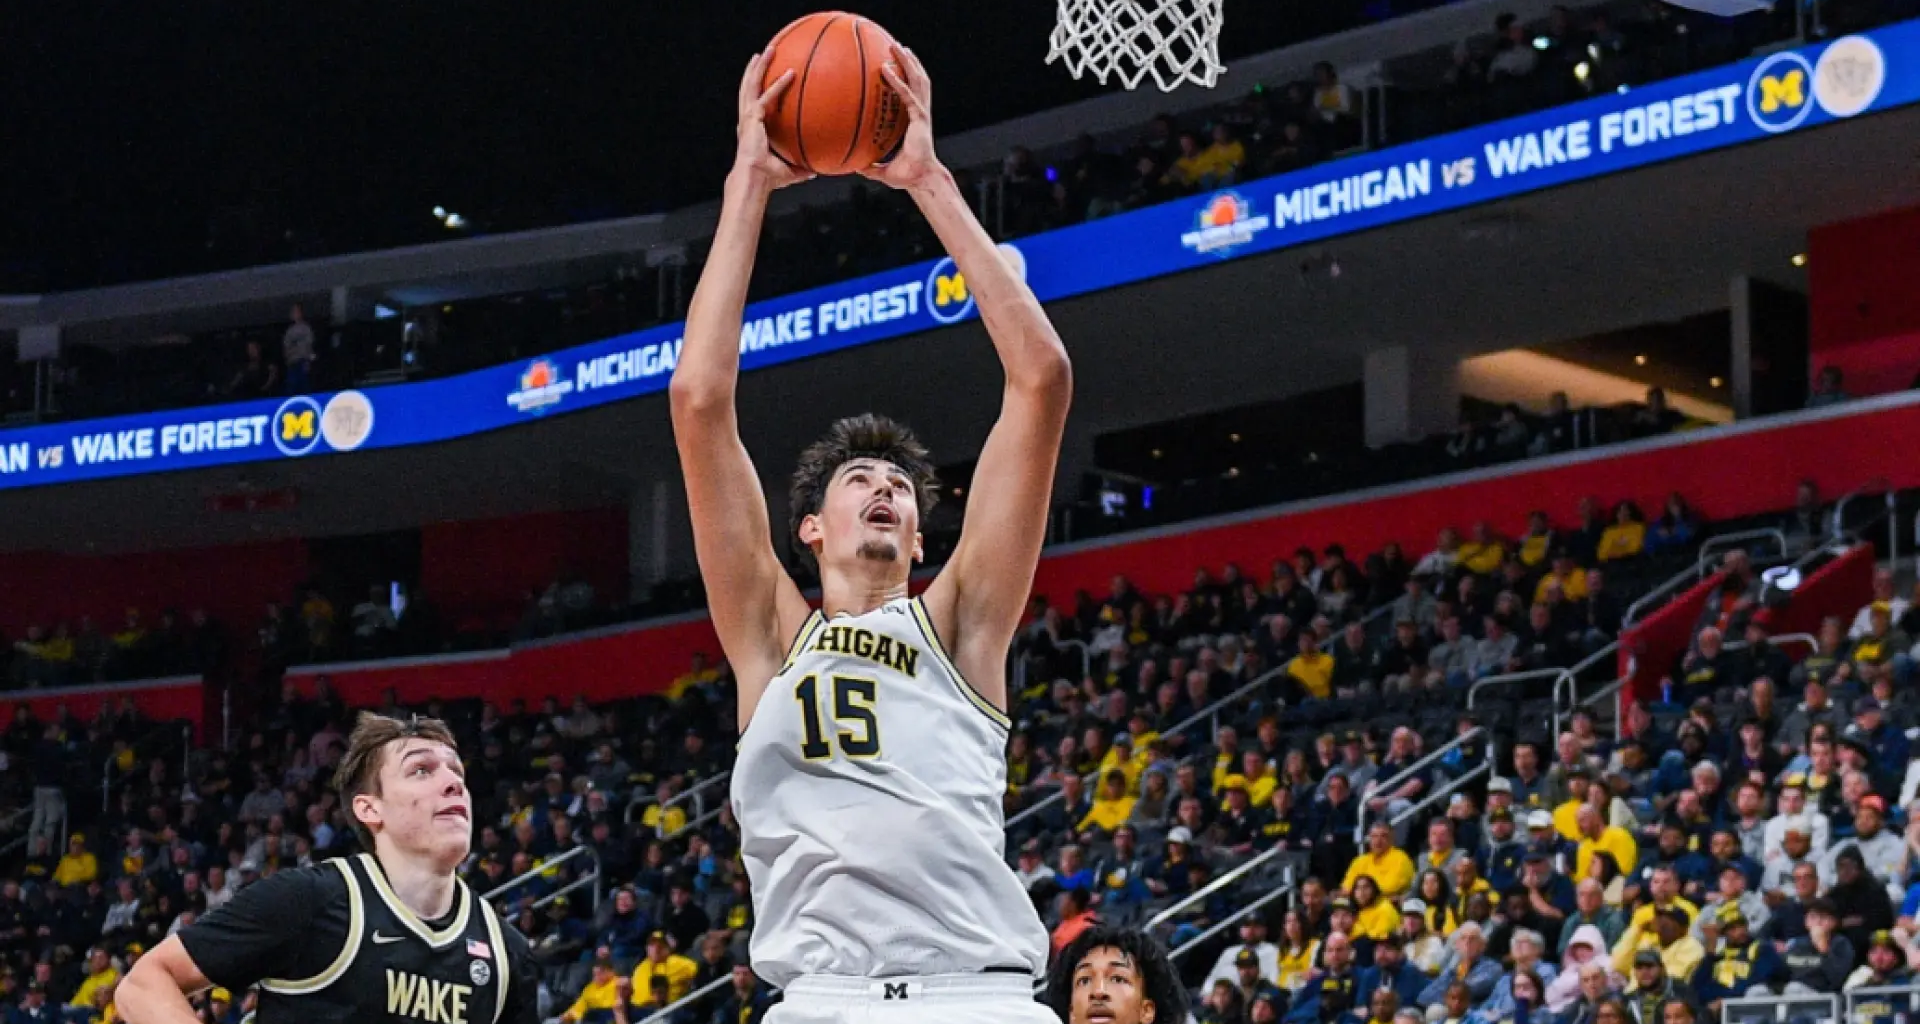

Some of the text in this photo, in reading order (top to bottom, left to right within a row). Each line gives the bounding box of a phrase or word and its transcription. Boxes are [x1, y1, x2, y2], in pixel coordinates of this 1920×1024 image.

[1760, 70, 1804, 112] M
[1275, 159, 1431, 229] MICHIGAN
[1484, 120, 1591, 178] WAKE
[1600, 83, 1742, 153] FOREST
[935, 271, 968, 306] M
[739, 280, 923, 354] WAKE FOREST
[577, 337, 684, 392] MICHIGA
[72, 428, 154, 466] WAKE
[161, 414, 269, 456] FOREST
[282, 411, 314, 440] M
[808, 625, 921, 680] HIGAN
[794, 674, 881, 759] 15
[386, 968, 473, 1024] WAKE
[883, 982, 909, 1000] M
